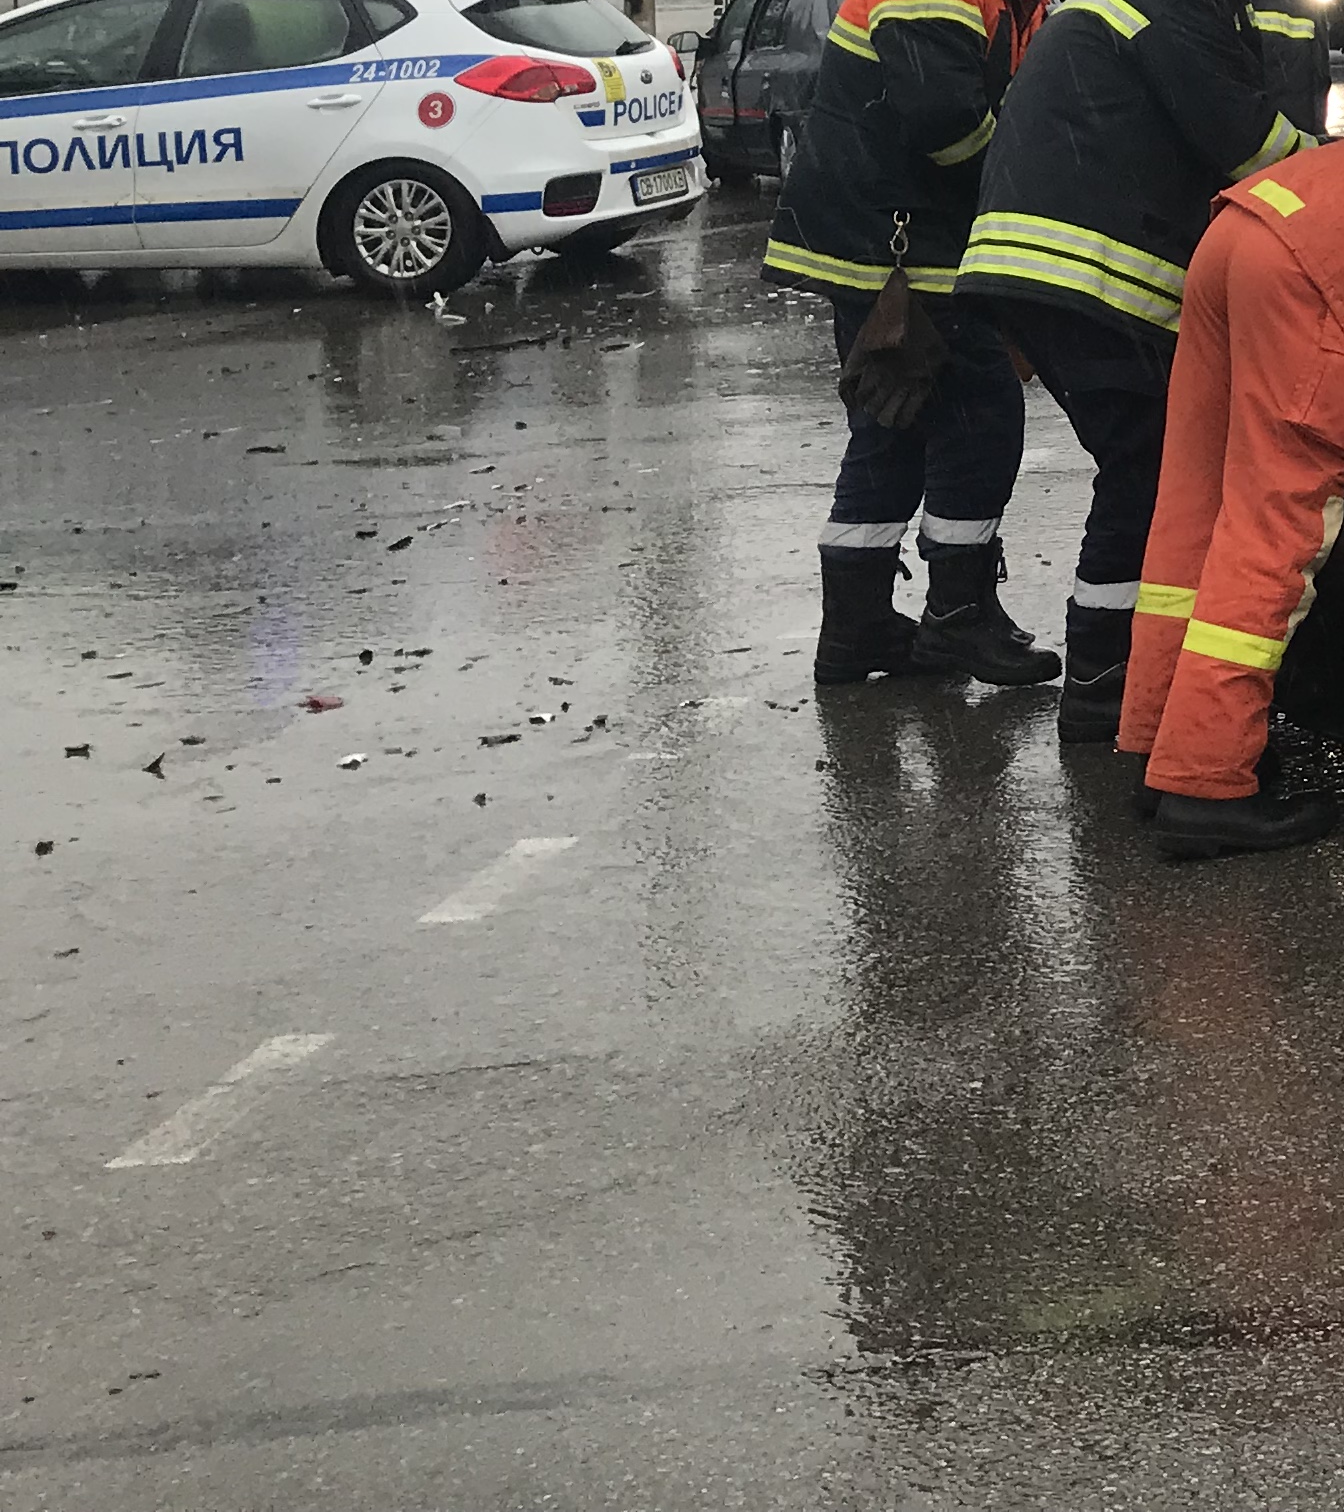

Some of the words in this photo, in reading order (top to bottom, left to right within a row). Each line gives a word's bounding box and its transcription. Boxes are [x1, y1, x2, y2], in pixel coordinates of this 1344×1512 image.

[349, 59, 441, 83] 24-1002
[428, 100, 443, 119] 3
[613, 91, 676, 126] POLICE
